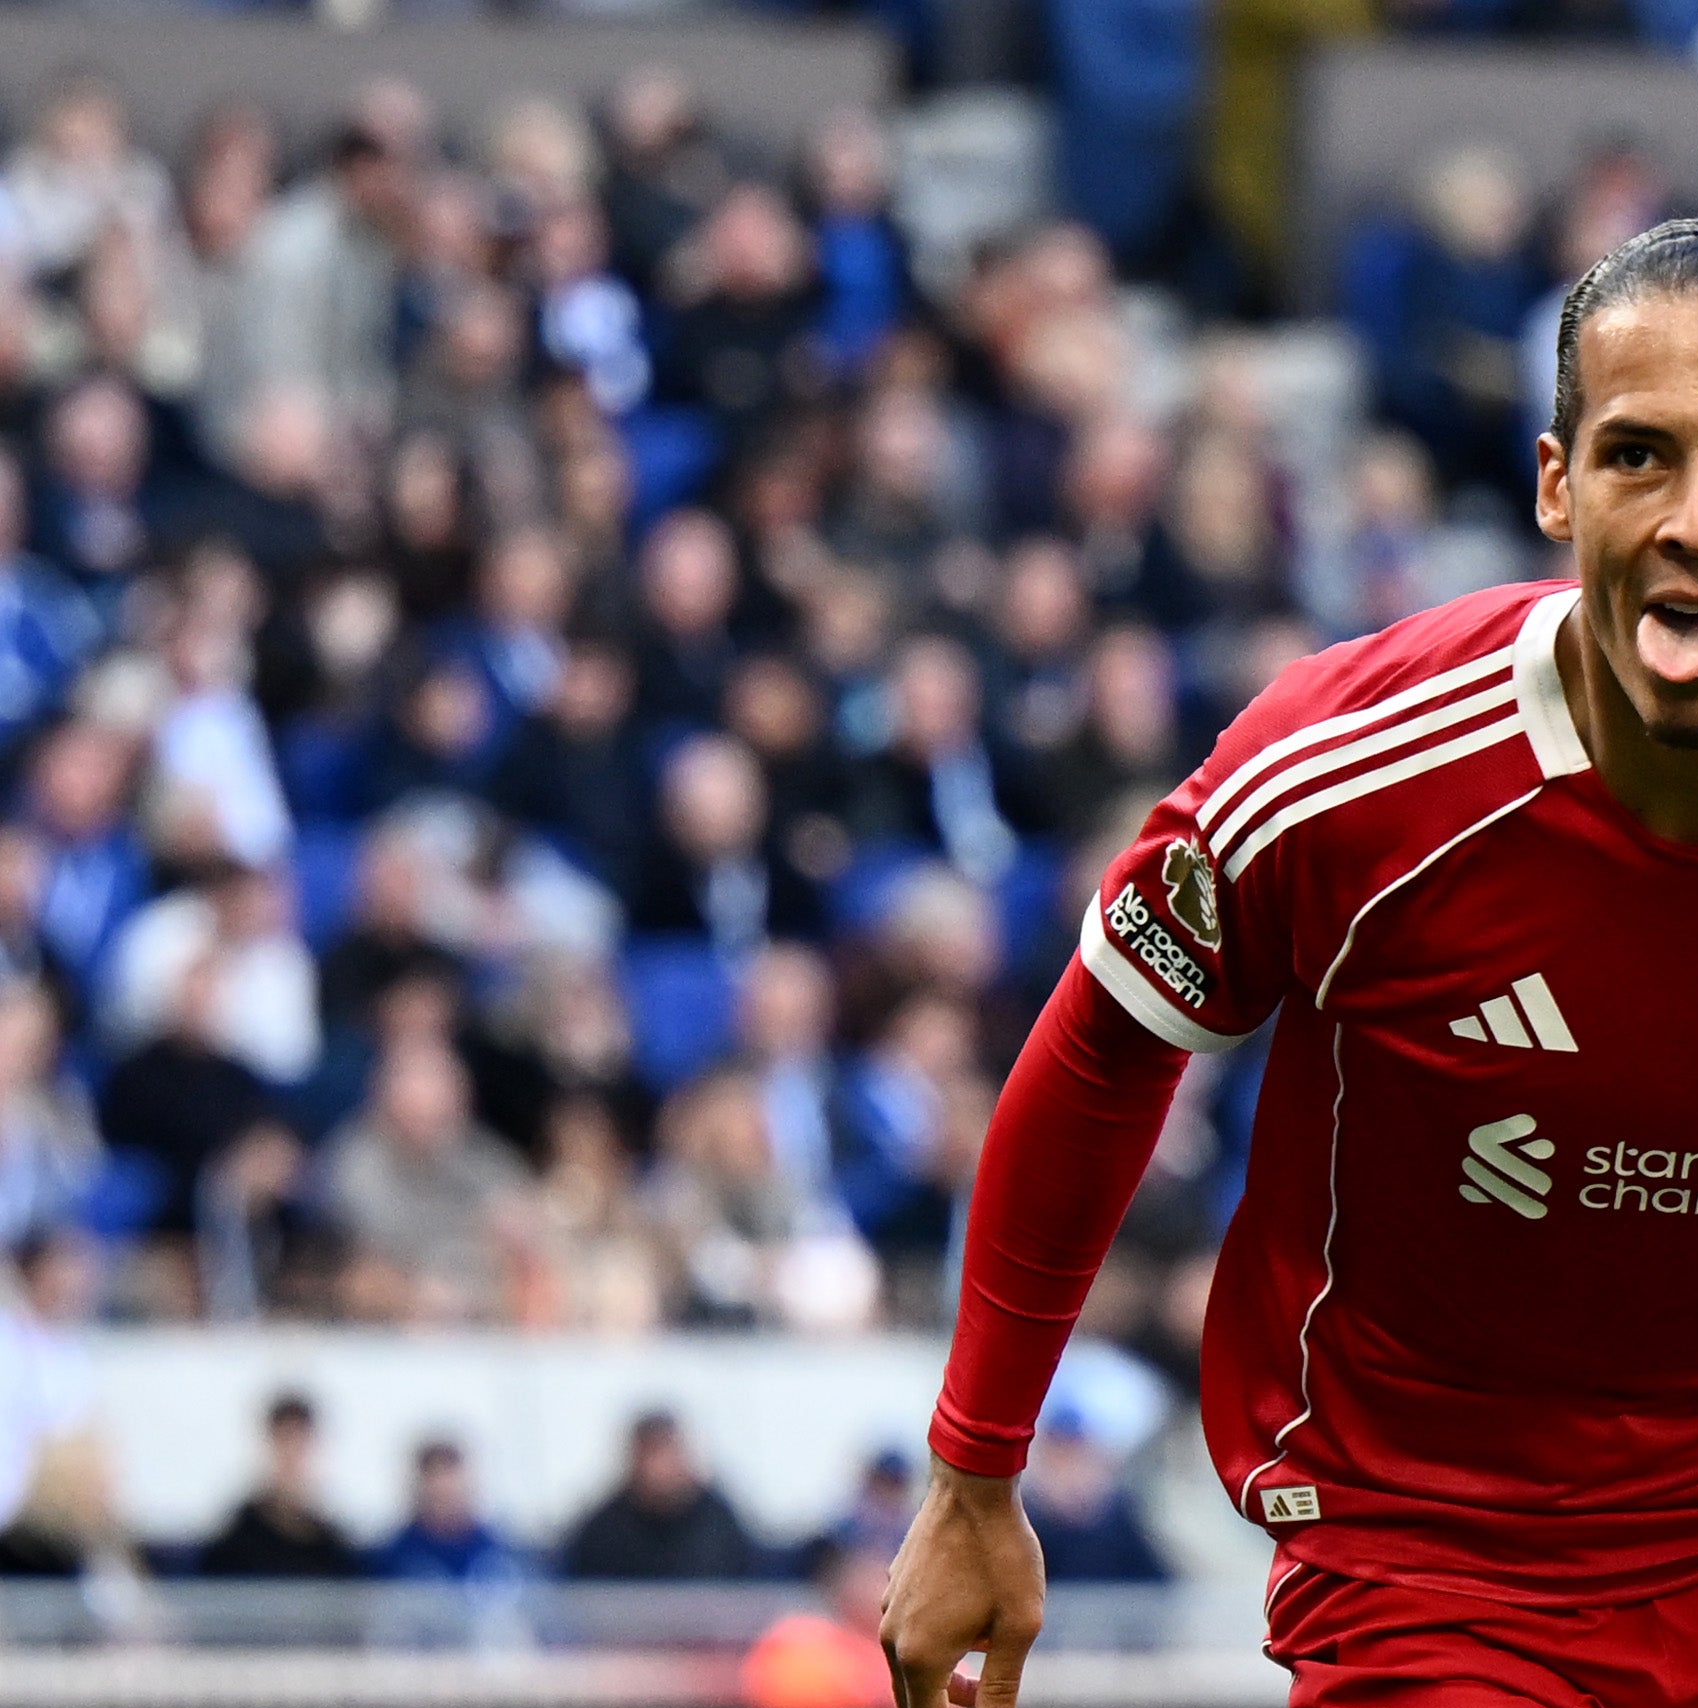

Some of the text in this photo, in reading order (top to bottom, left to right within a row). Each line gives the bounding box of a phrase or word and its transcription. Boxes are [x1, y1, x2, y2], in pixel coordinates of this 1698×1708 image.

[1118, 881, 1205, 985] No room
[1130, 934, 1206, 1009] racism
